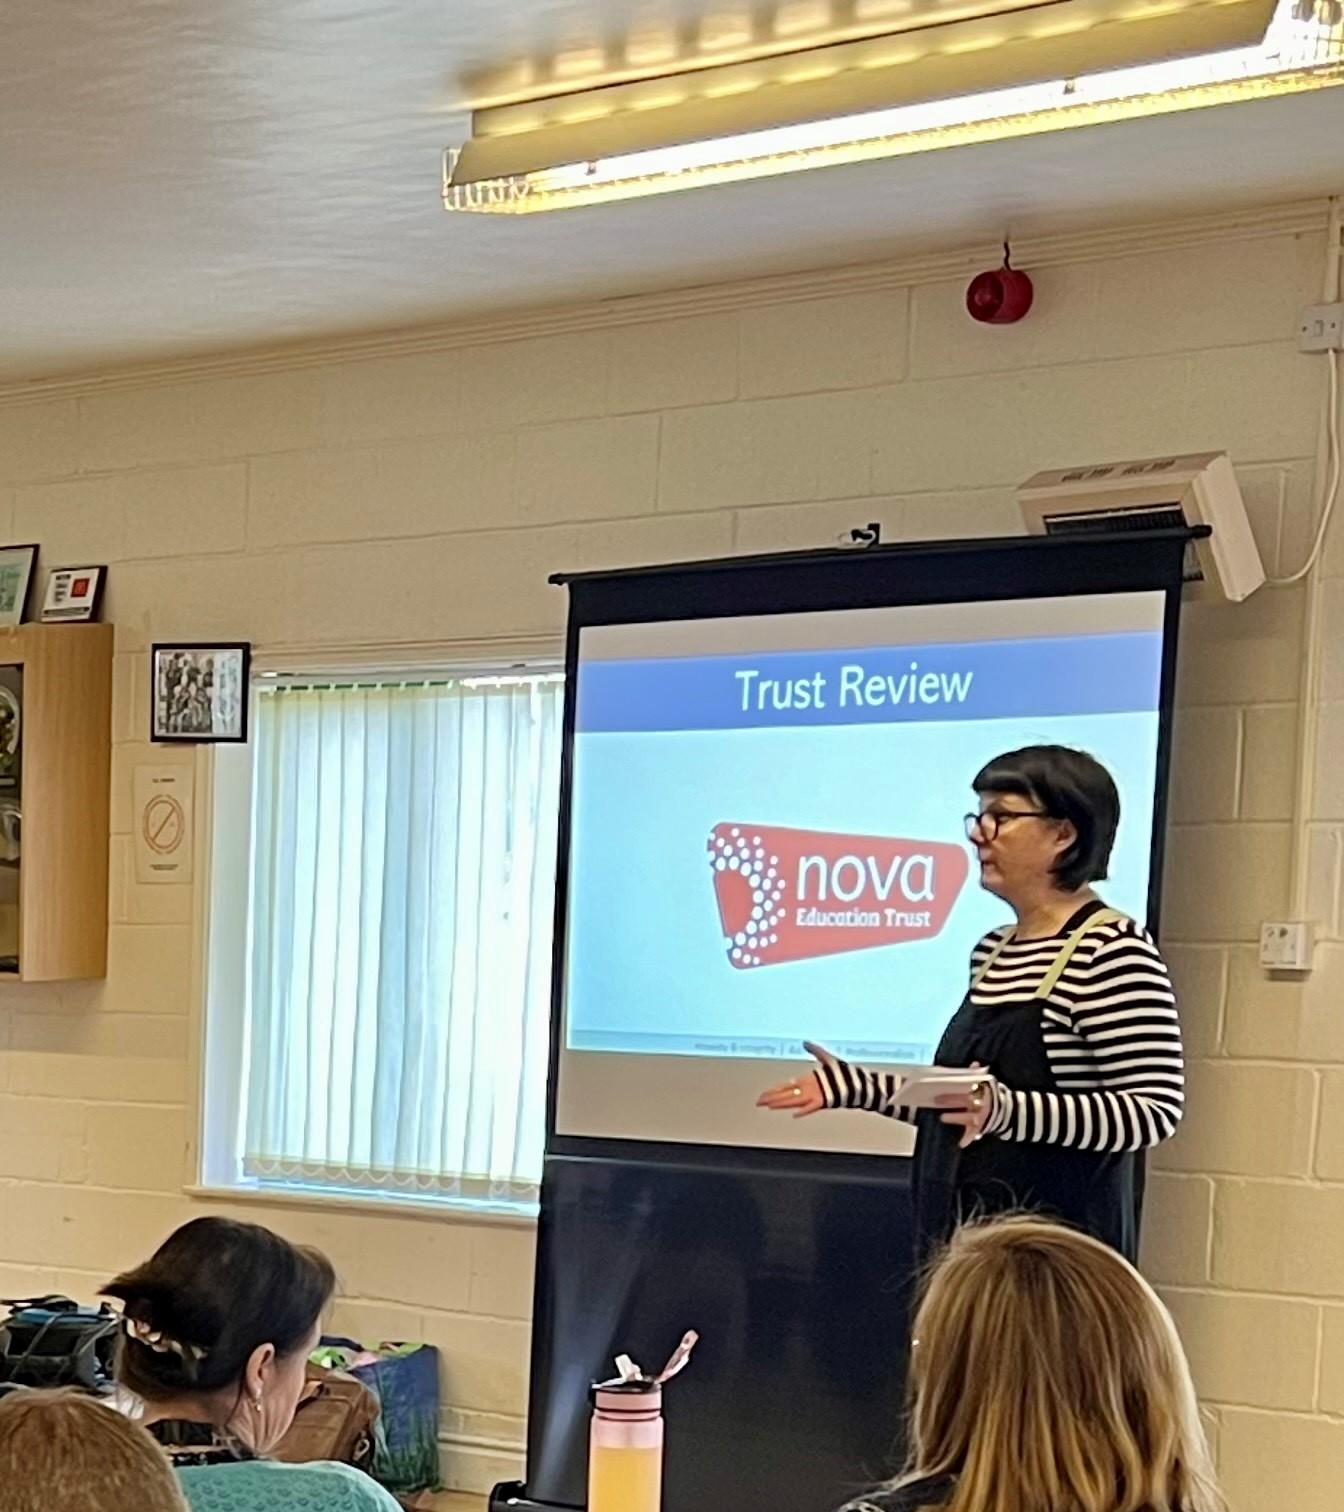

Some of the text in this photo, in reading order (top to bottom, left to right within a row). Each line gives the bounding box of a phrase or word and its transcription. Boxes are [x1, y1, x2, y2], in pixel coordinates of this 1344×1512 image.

[735, 661, 973, 711] Trust Review
[796, 855, 934, 902] nova
[796, 907, 931, 927] Education Trust
